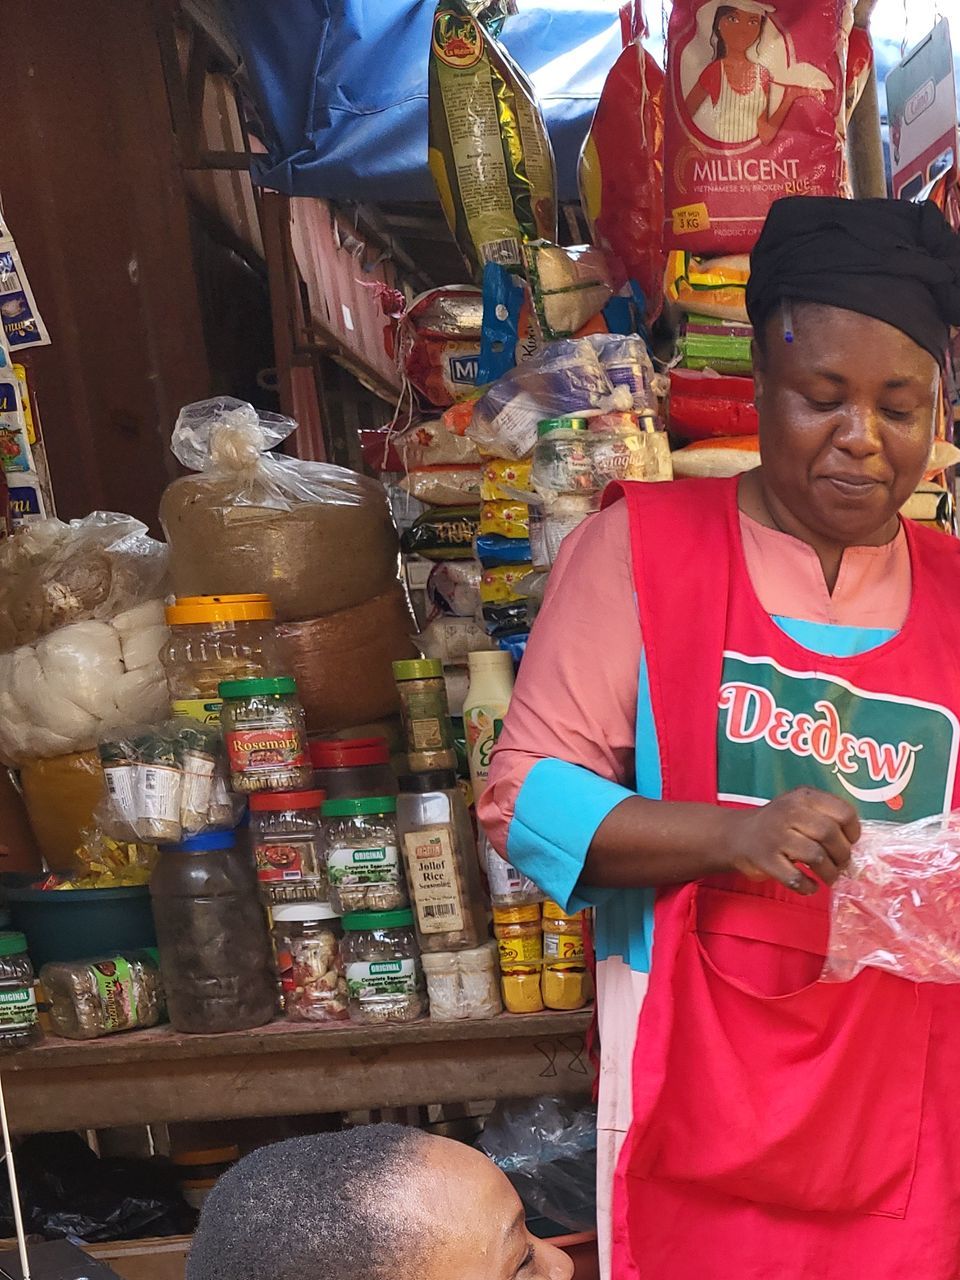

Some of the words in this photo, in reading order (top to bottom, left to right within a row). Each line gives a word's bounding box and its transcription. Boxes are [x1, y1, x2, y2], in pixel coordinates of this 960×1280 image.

[693, 159, 800, 182] MILLICENT
[784, 178, 811, 195] RICE
[687, 218, 700, 229] KG
[233, 737, 298, 752] Rosemary
[354, 851, 384, 861] ORIGINAL
[418, 859, 446, 872] Jollof
[422, 872, 445, 882] Rice
[370, 963, 401, 973] ORIGINAL
